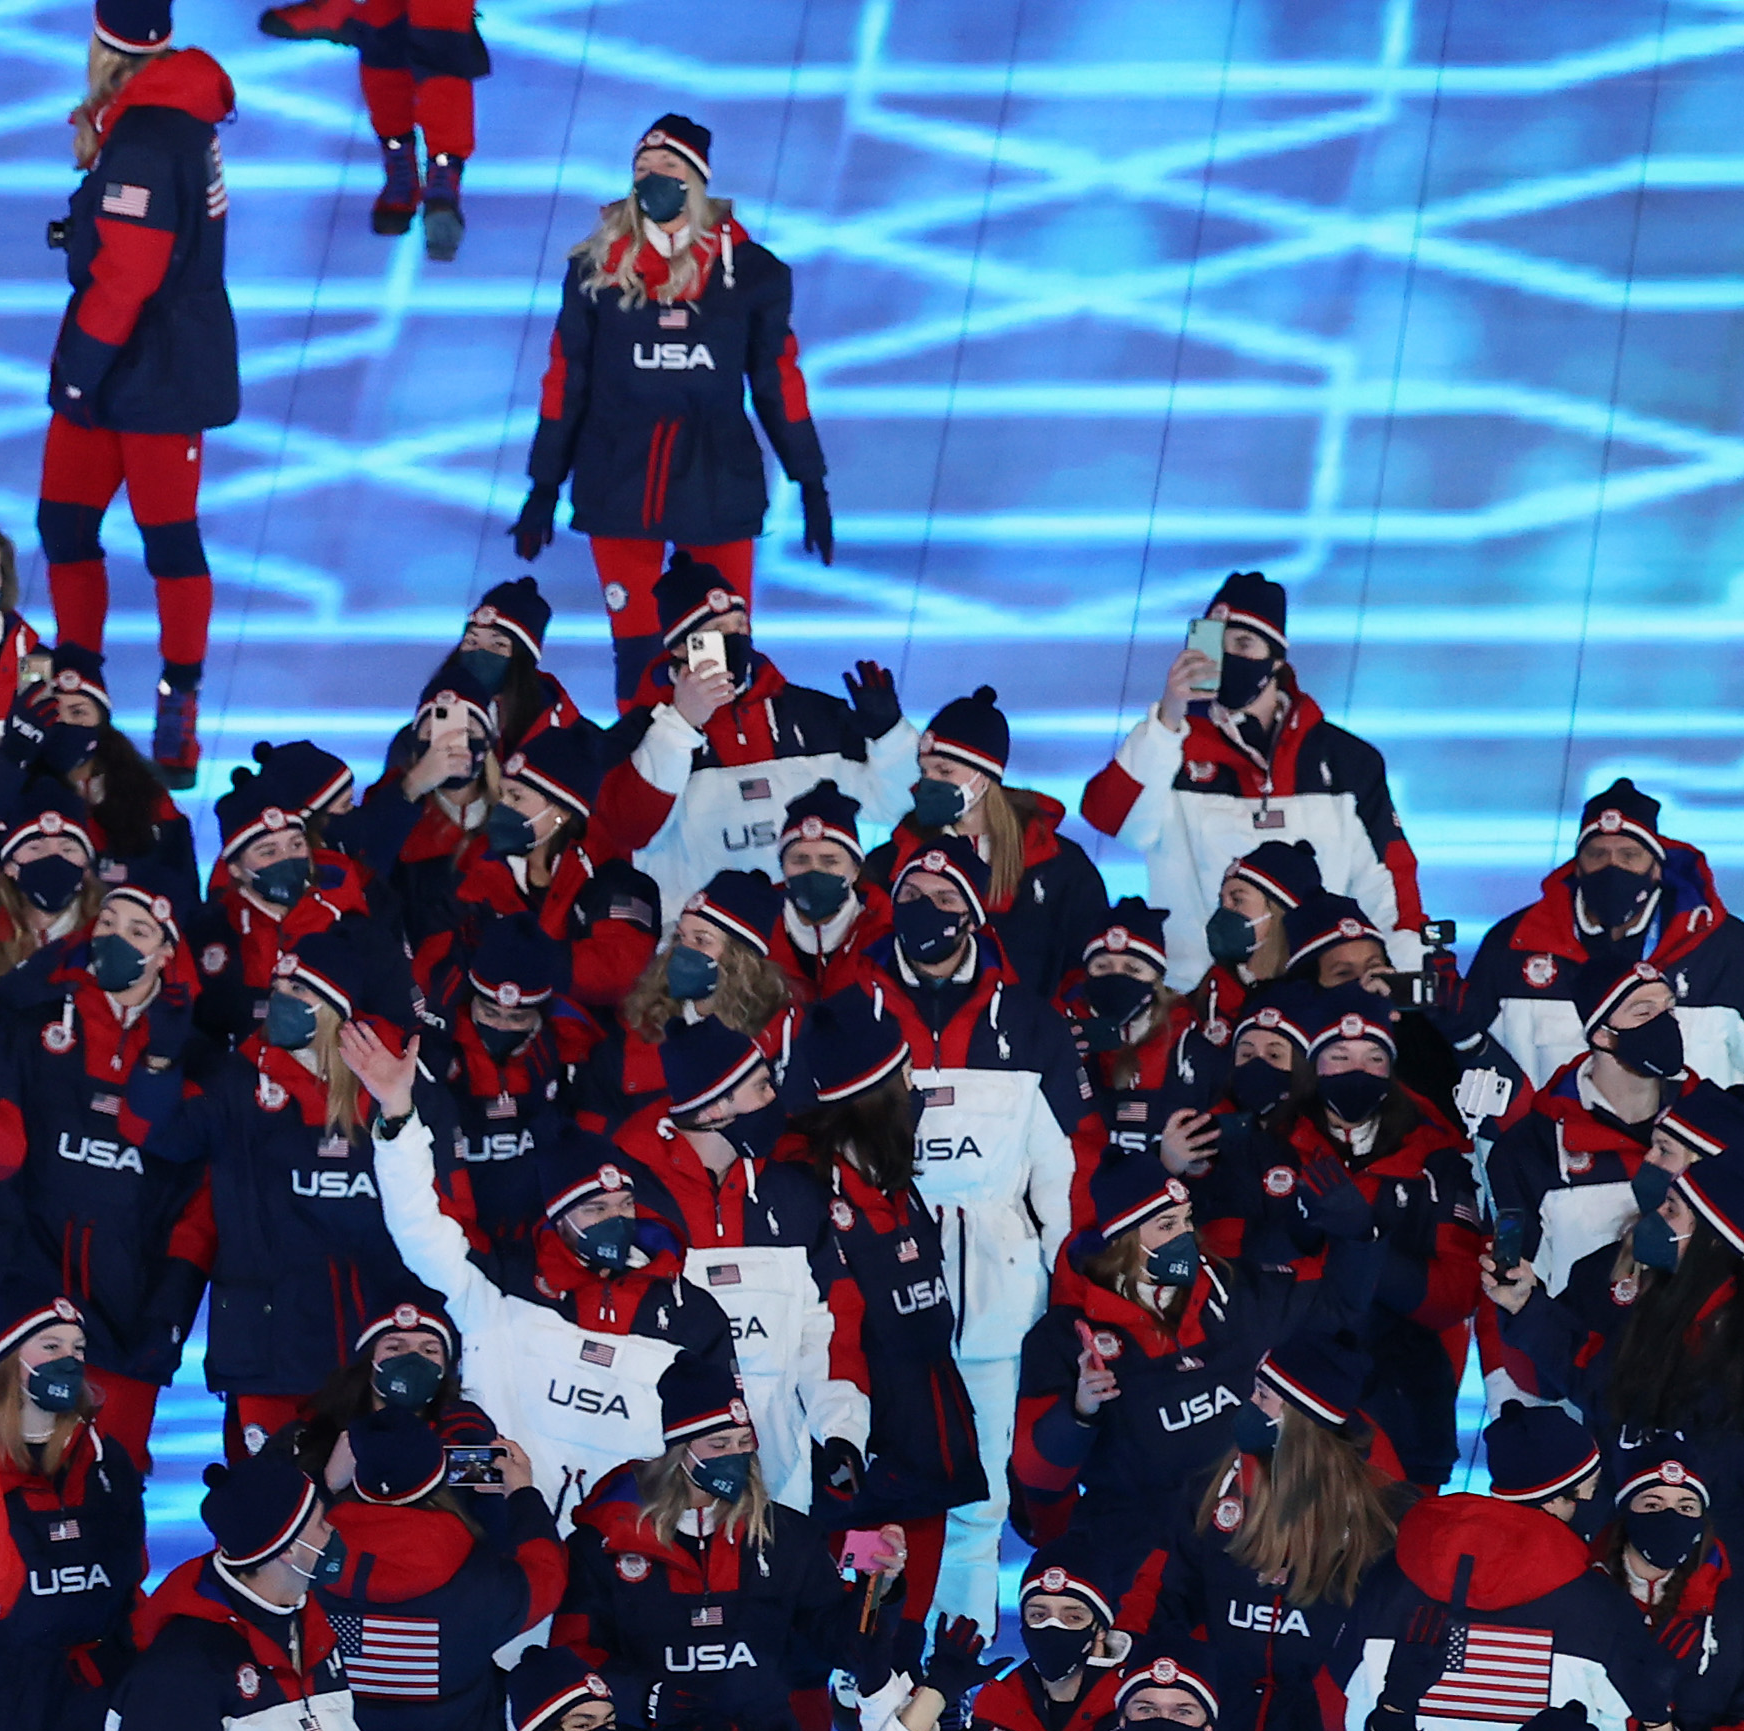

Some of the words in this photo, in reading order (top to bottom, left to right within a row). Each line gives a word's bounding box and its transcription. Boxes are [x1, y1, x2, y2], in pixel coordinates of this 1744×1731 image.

[634, 343, 715, 371] USA
[723, 821, 775, 850] US
[59, 1132, 143, 1173] USA
[464, 1128, 536, 1161] USA
[292, 1172, 378, 1199] USA
[1169, 1263, 1188, 1276] USA
[892, 1279, 947, 1314] USA
[730, 1316, 767, 1339] SA
[549, 1379, 630, 1419] USA
[1160, 1384, 1241, 1432] USA
[30, 1566, 111, 1595] USA
[1228, 1600, 1310, 1636] USA
[665, 1645, 758, 1671] USA
